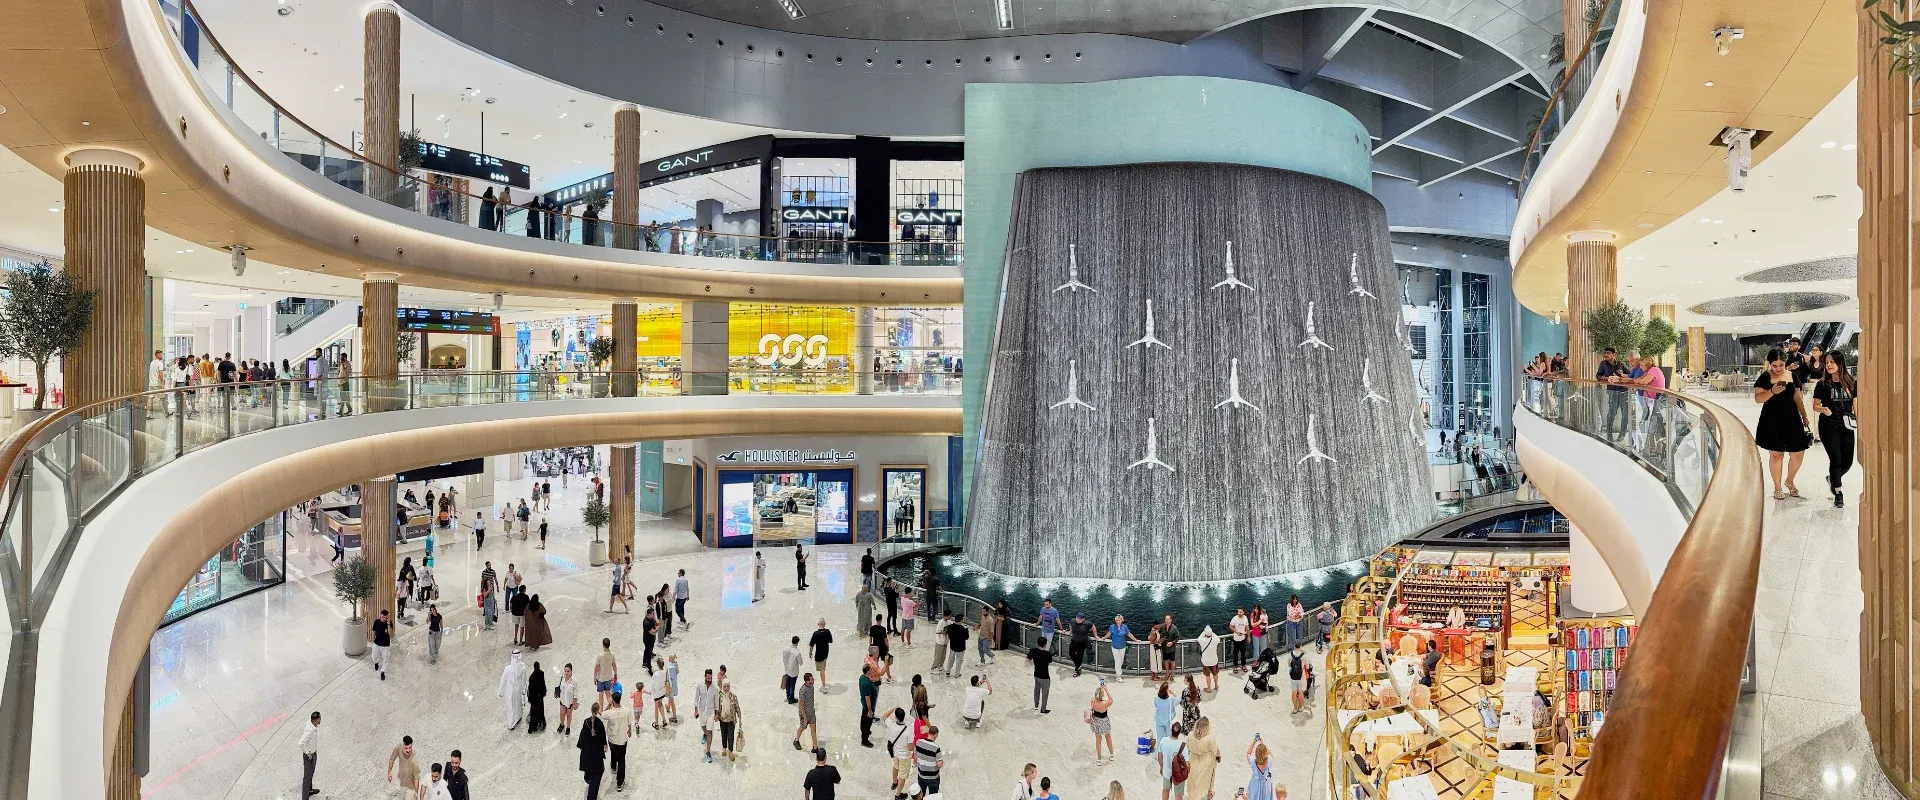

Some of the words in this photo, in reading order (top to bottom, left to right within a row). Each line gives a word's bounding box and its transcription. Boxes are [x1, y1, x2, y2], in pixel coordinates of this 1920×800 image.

[657, 150, 714, 172] GANT
[556, 177, 607, 202] CASTORE
[783, 209, 848, 221] GANT
[897, 211, 962, 223] GANT
[744, 449, 800, 463] HOLLISTER
[801, 448, 856, 464] هوليستر
